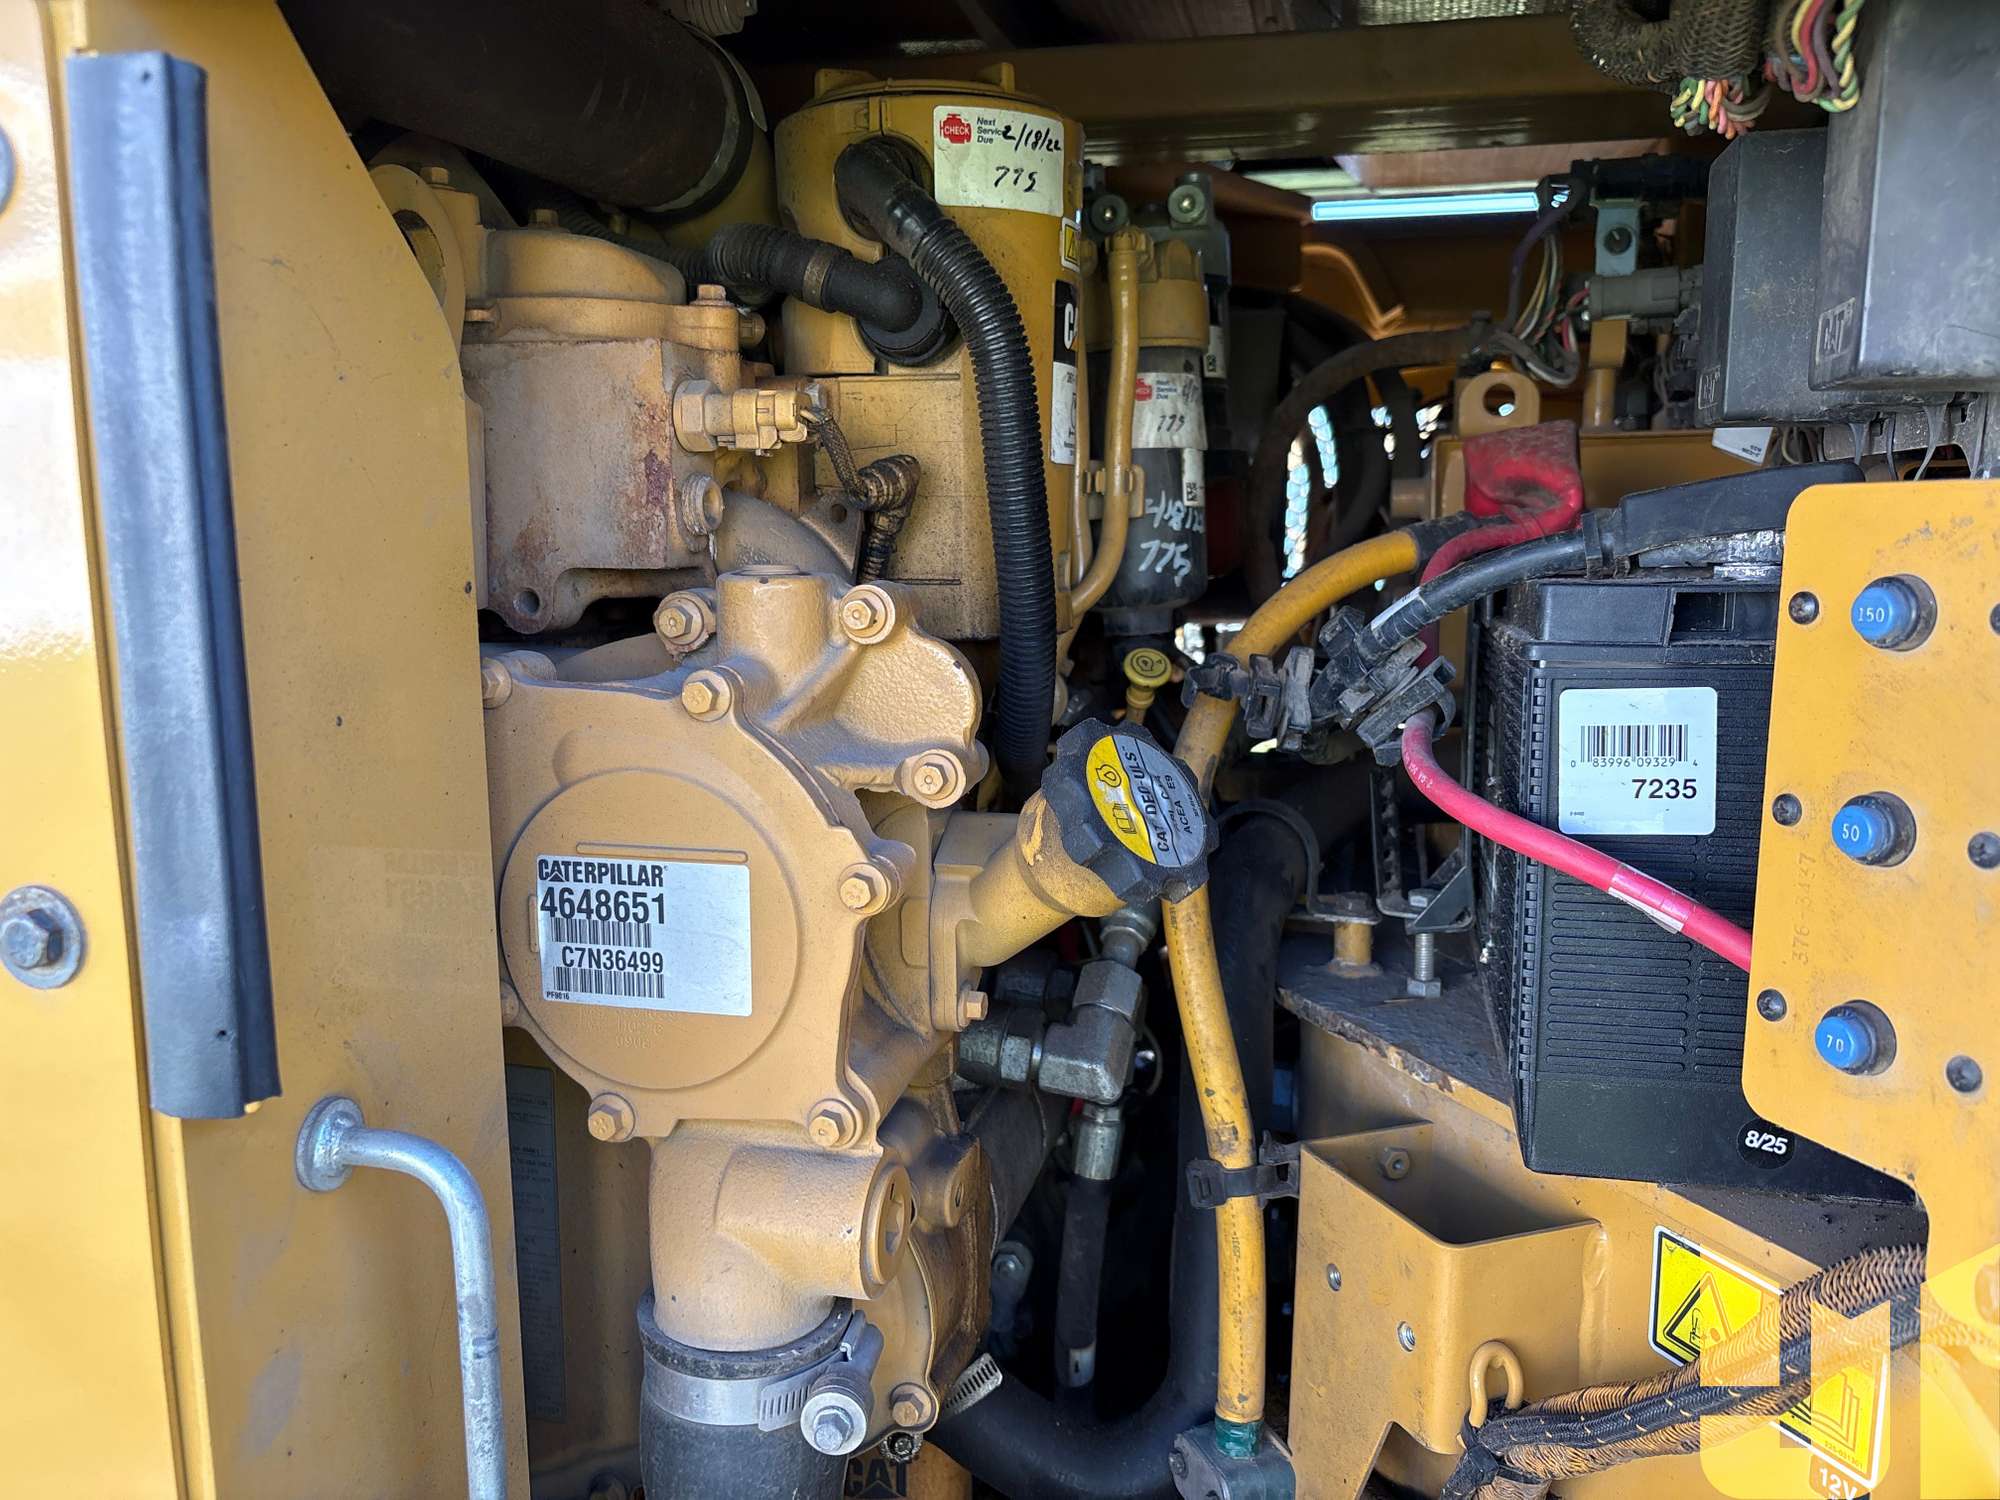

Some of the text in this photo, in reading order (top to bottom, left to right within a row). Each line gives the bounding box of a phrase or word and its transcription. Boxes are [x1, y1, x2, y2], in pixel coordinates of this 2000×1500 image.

[944, 126, 970, 136] CHECK
[976, 116, 996, 126] Next
[976, 126, 1003, 136] Servic
[976, 135, 994, 144] Due
[1138, 540, 1192, 587] 775
[1857, 607, 1885, 623] 150
[1570, 760, 1576, 768] 0
[1592, 757, 1631, 768] 83996
[1636, 757, 1676, 768] 09329
[1631, 778, 1697, 800] 7235
[1174, 800, 1193, 834] ACEA
[1841, 823, 1860, 842] 50
[538, 859, 664, 887] CATERPILLAR
[540, 887, 665, 924] 4648651
[562, 946, 664, 973] C7N36499
[1826, 1034, 1844, 1053] 70
[1744, 1130, 1787, 1154] 8/25
[1819, 1467, 1858, 1500] 12V
